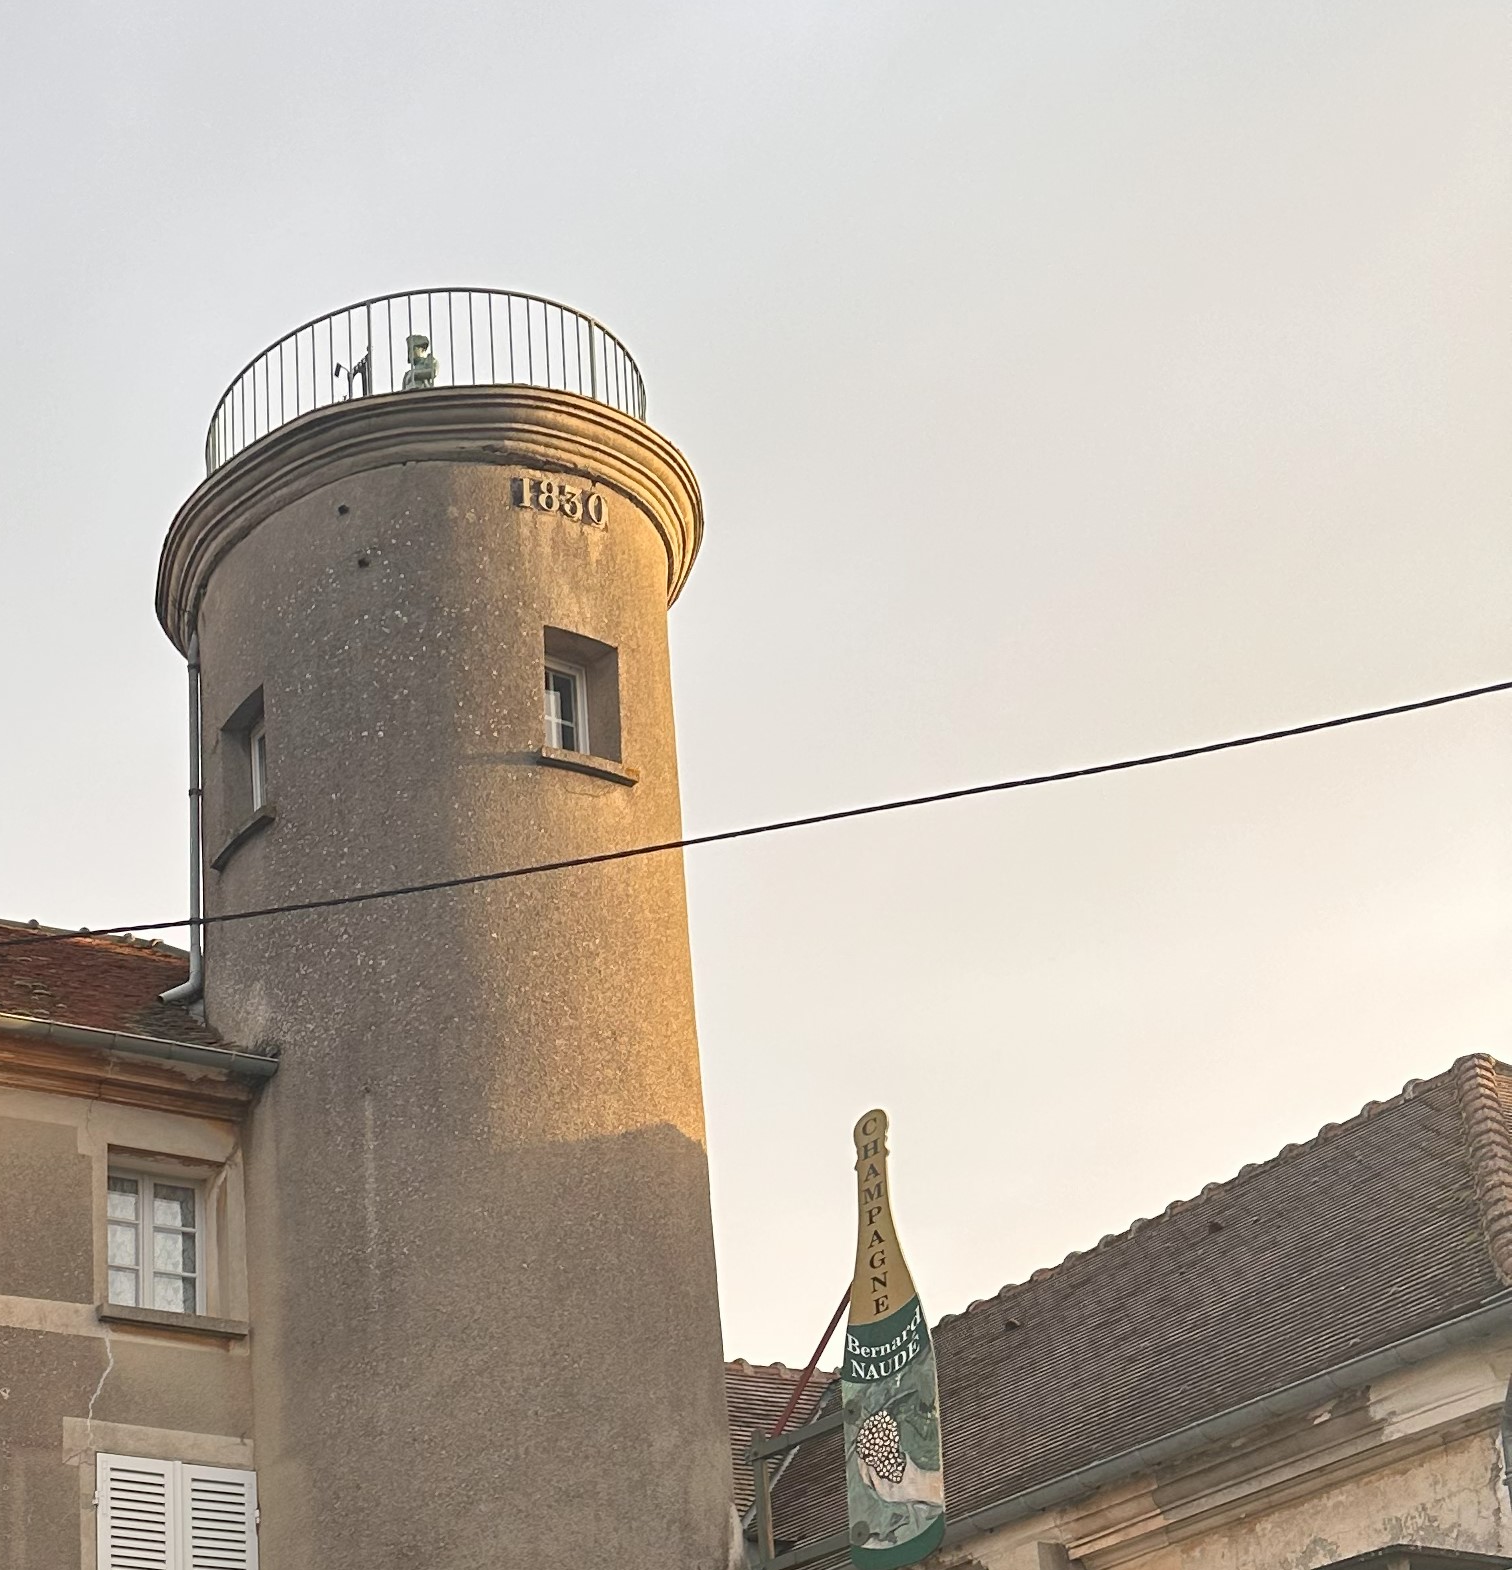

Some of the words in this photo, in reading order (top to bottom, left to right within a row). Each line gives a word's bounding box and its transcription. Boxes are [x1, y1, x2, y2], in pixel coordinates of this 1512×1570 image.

[515, 477, 608, 527] 1830
[861, 1117, 890, 1316] CHAMPAGNE
[846, 1304, 922, 1358] Bernard
